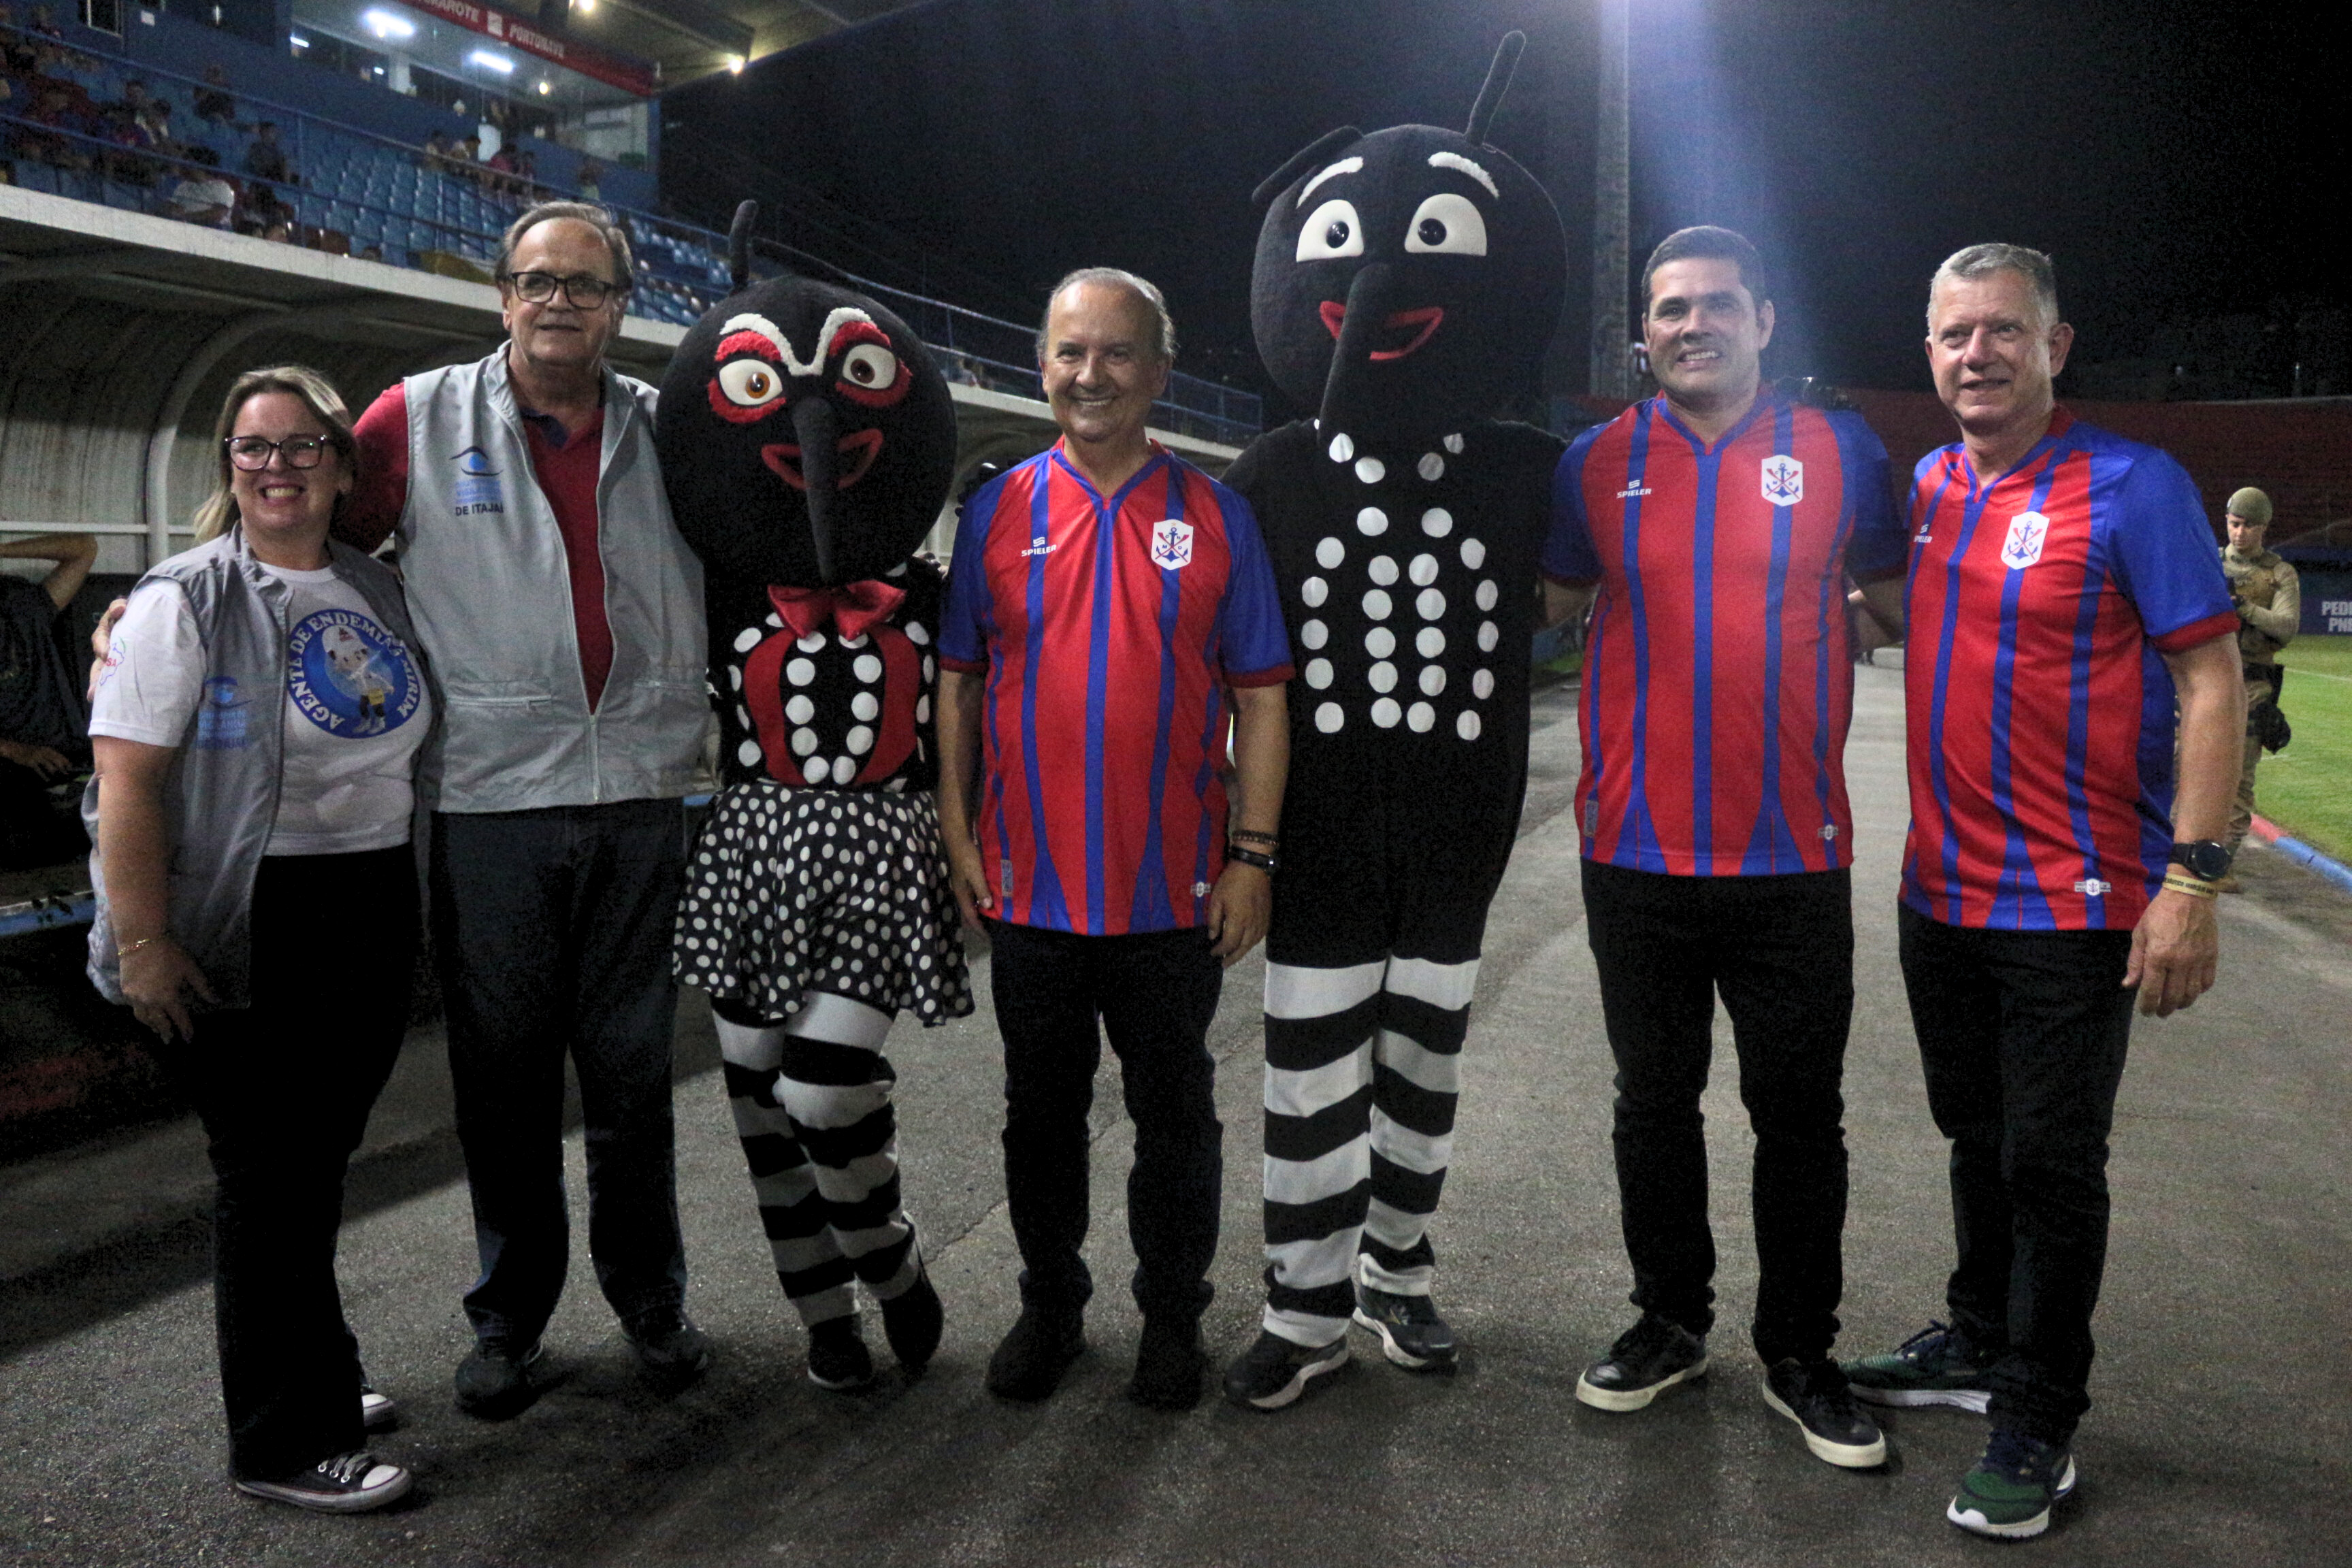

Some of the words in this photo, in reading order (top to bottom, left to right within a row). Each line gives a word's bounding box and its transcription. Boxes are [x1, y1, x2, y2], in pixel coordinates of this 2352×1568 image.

[1616, 488, 1652, 499] SPIELER
[455, 506, 469, 516] DE
[1021, 544, 1057, 557] SPIELER
[290, 627, 313, 655] DE
[288, 657, 346, 730] AGENTE
